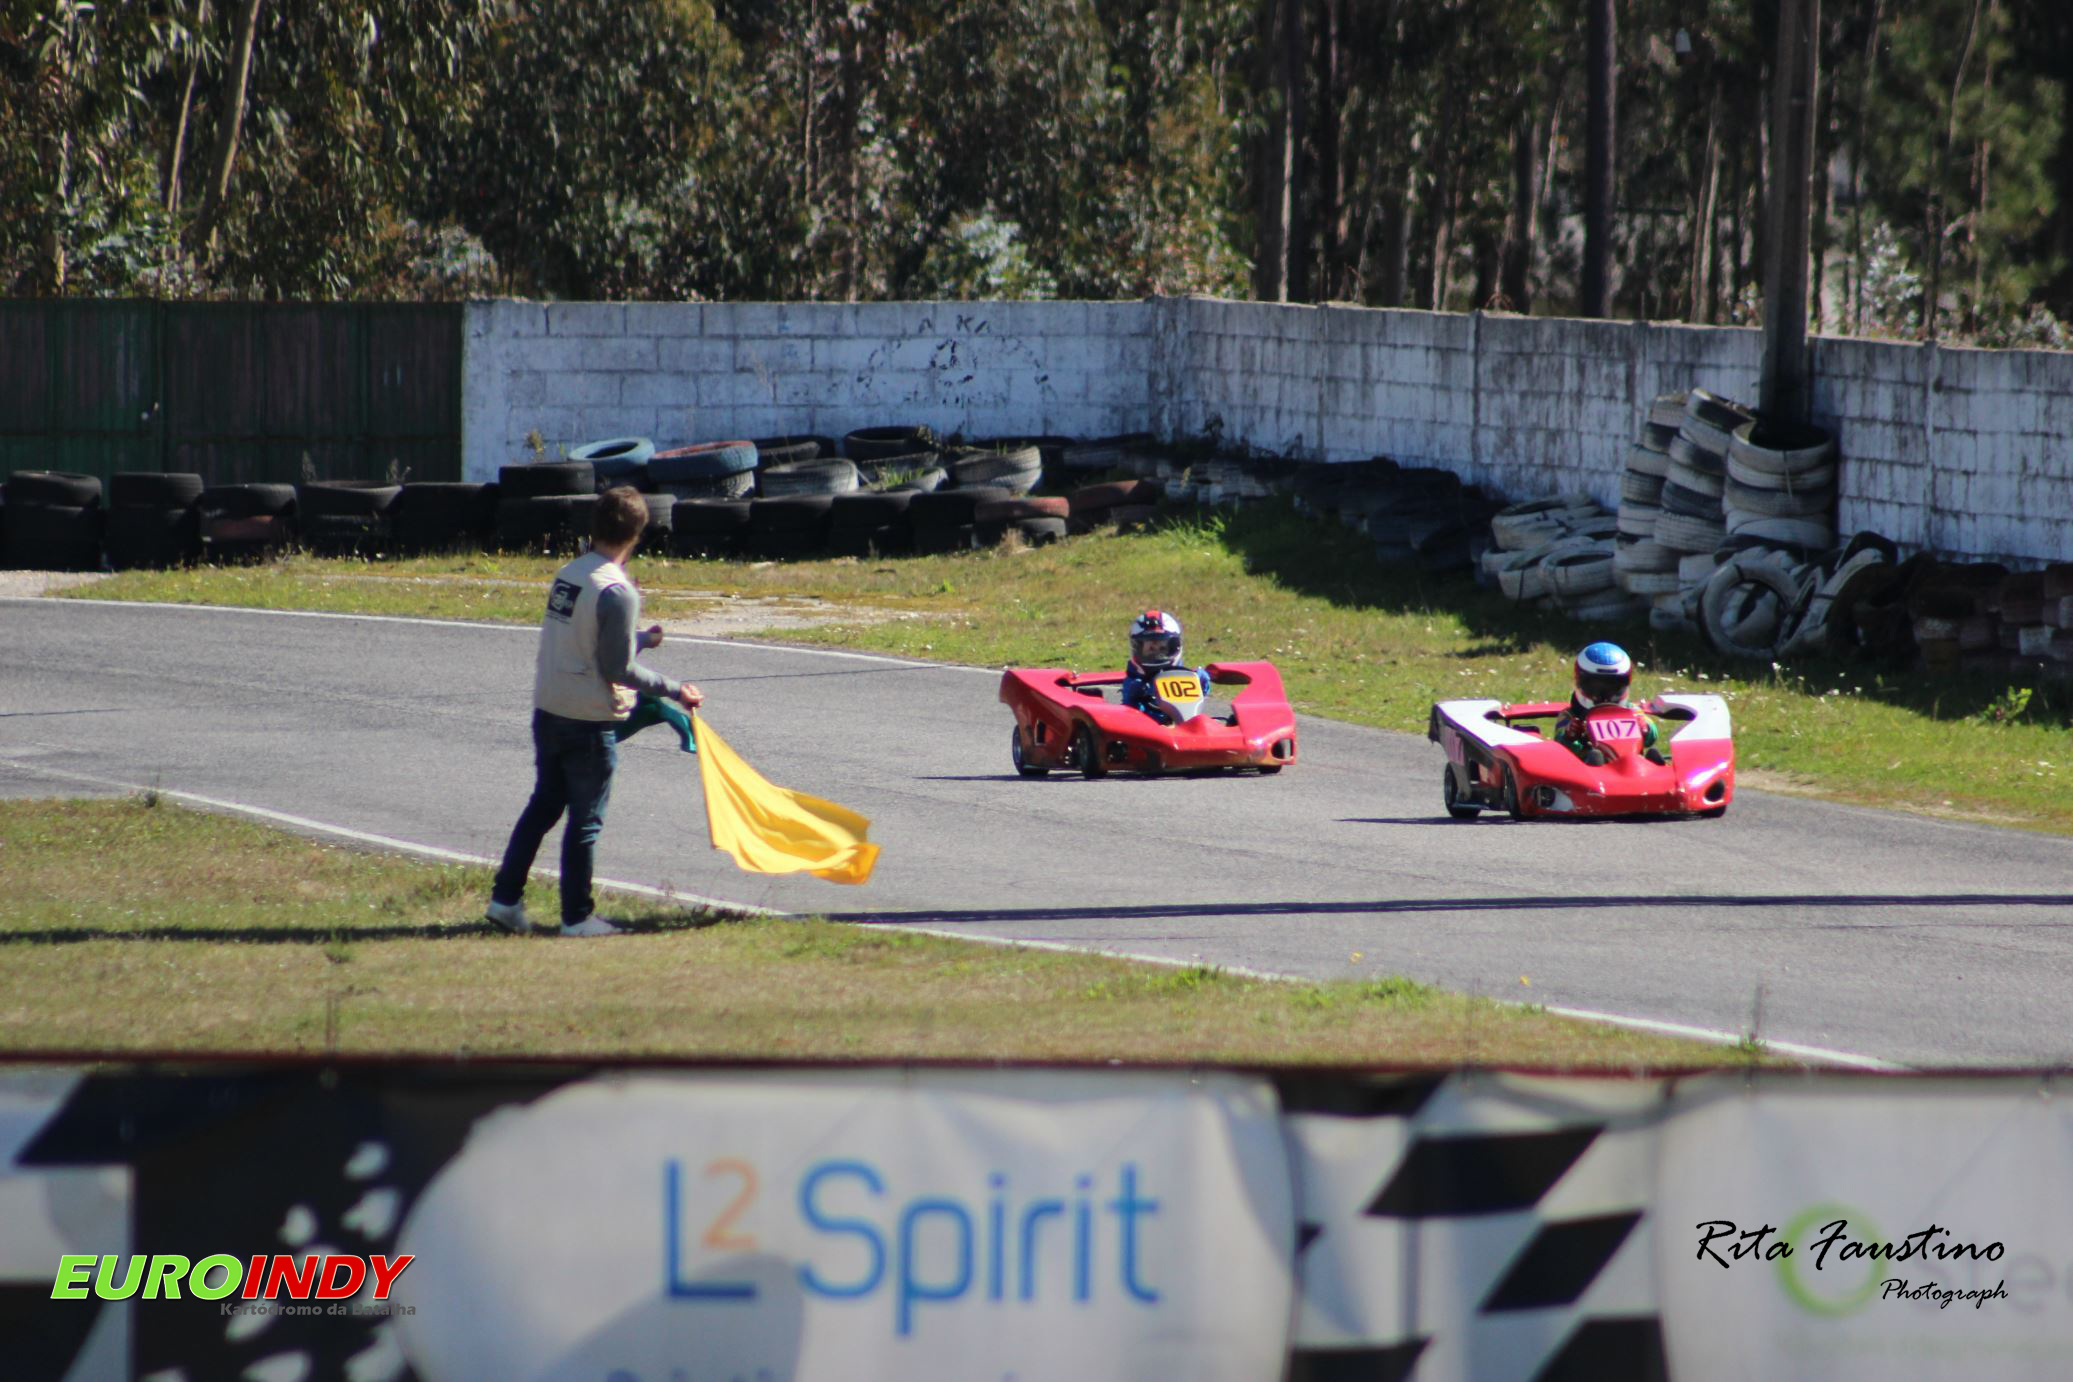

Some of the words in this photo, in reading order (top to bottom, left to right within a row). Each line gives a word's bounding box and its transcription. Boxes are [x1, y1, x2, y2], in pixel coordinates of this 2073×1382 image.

[1162, 680, 1200, 698] 102
[1596, 719, 1636, 739] 107
[796, 1158, 1161, 1338] Spirit
